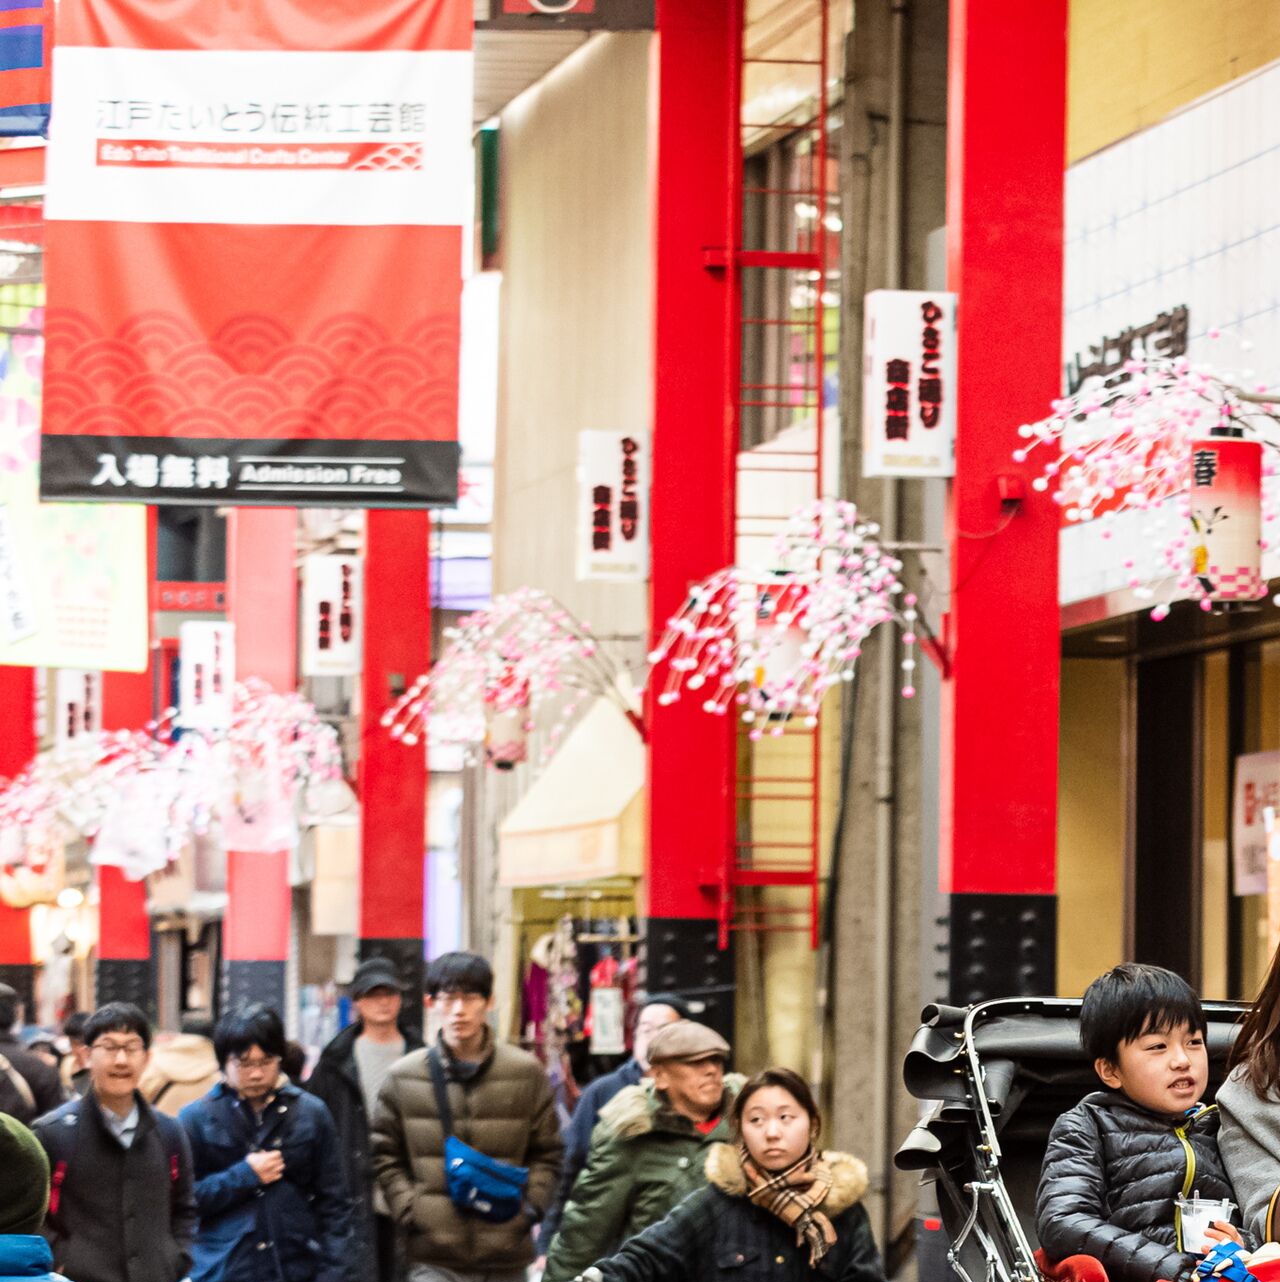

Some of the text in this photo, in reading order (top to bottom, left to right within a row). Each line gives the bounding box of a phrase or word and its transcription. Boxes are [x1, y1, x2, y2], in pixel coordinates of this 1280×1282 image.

[97, 99, 427, 133] 江戸たいとう伝統工芸館
[91, 453, 230, 488] 入場無料
[239, 463, 402, 485] Admission Free
